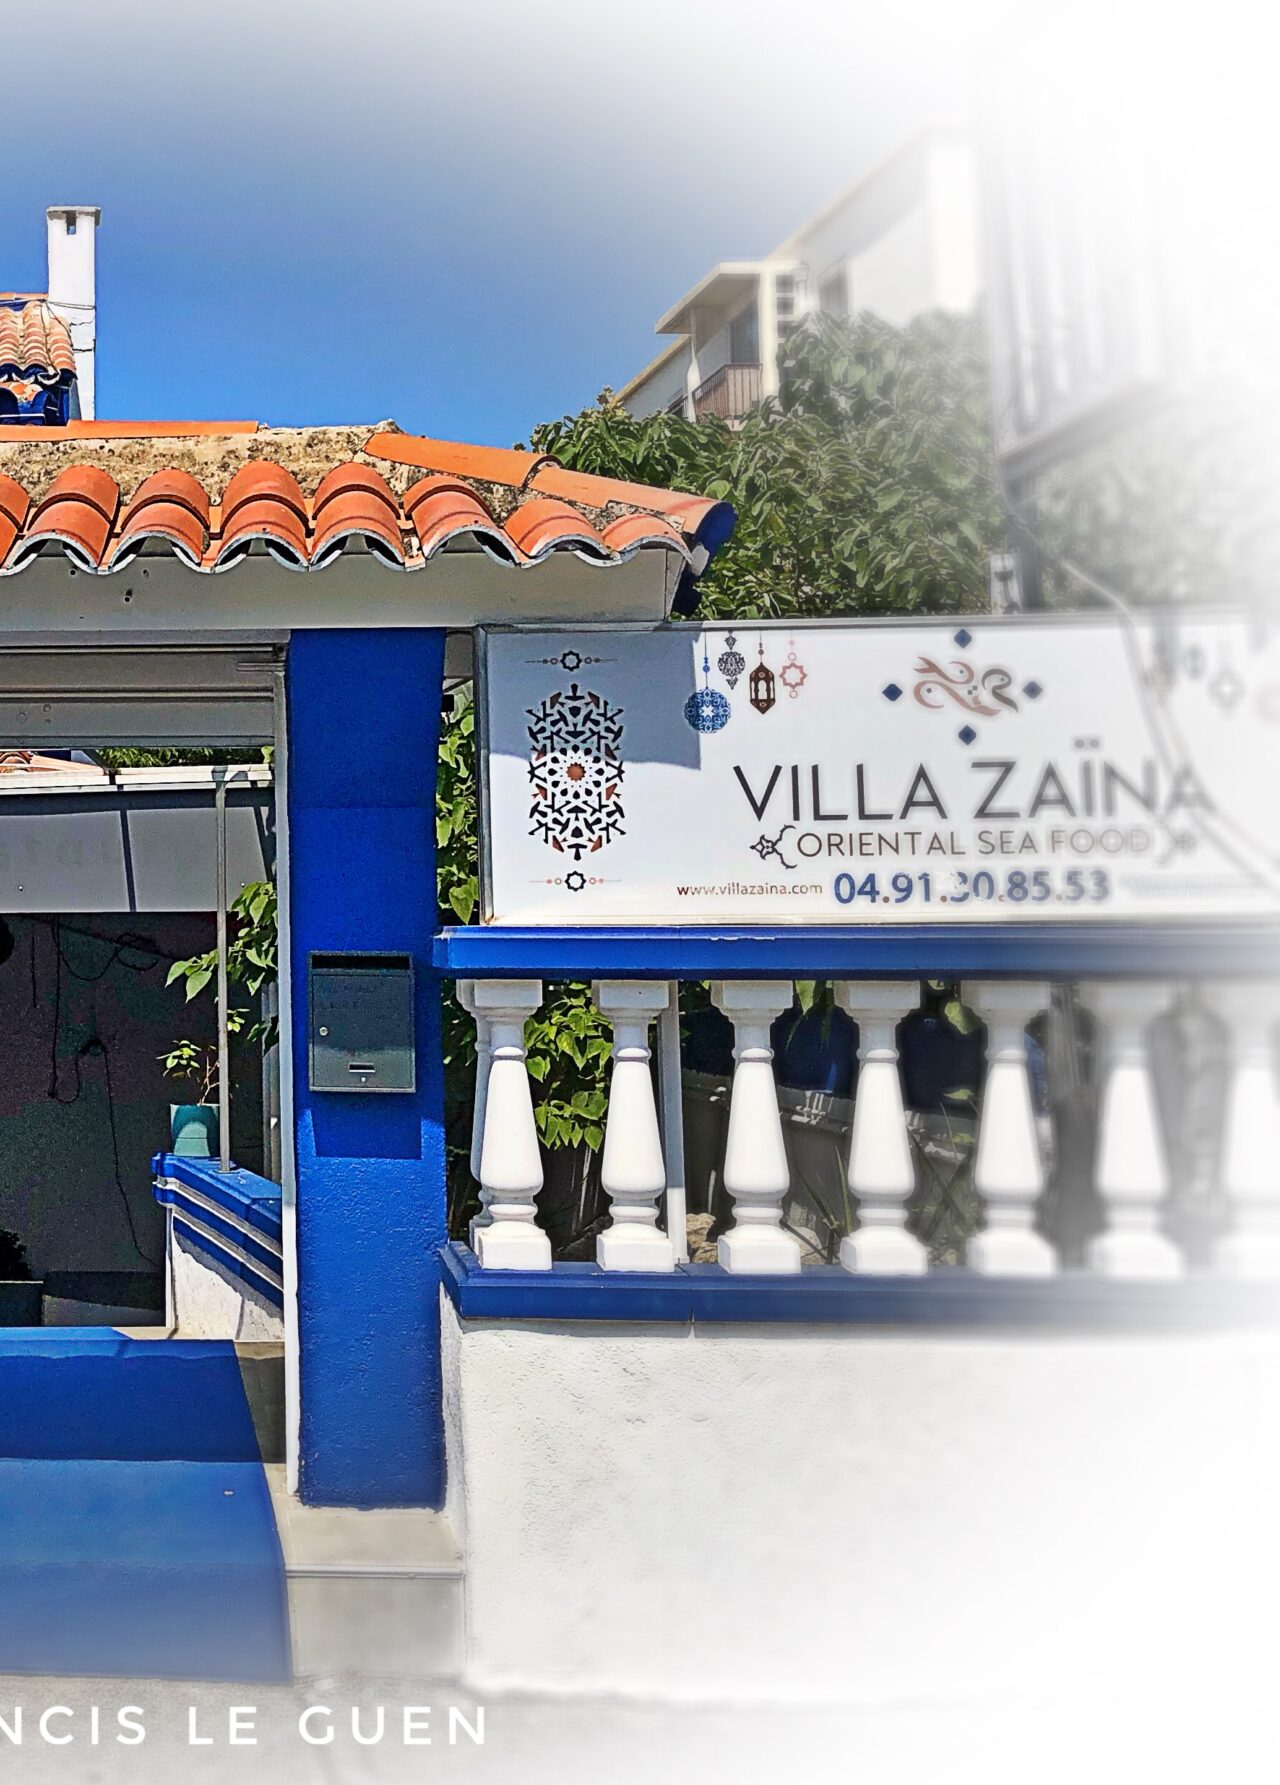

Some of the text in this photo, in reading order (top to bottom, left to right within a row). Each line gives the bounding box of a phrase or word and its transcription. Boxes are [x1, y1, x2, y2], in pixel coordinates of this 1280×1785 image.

[732, 736, 1218, 824] VILLA ZAÏNA
[796, 828, 1152, 859] ORIENTAL SEA FOOD
[676, 881, 823, 897] www.villazaina.com
[833, 869, 1111, 905] 04.91.30.85.53
